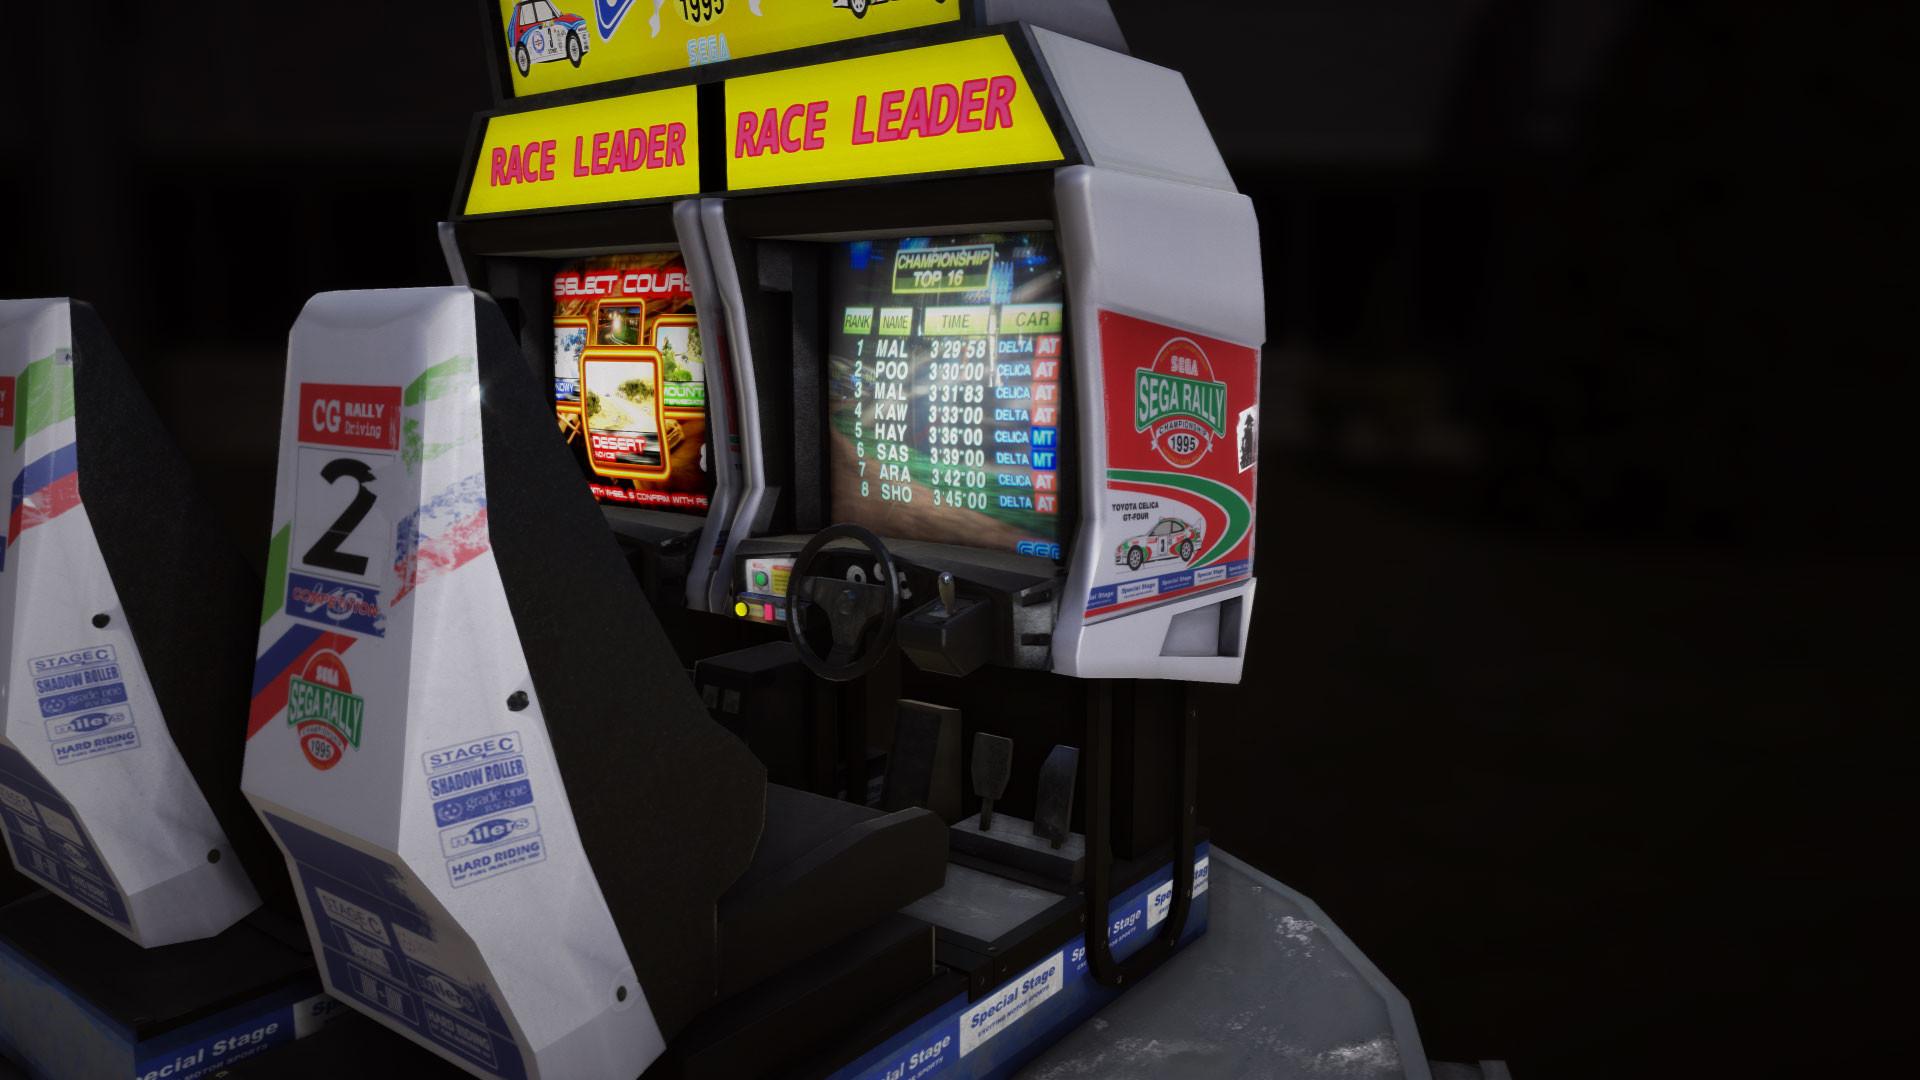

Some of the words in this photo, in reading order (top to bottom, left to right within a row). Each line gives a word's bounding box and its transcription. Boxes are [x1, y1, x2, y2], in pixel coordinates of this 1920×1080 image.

[687, 32, 731, 67] SEGA
[734, 101, 828, 158] RACE
[851, 75, 1017, 145] LEADER
[490, 139, 556, 187] RACE
[573, 122, 686, 178] LEADER
[898, 250, 990, 269] CHAMPIONSHIP
[554, 275, 618, 296] SELECT
[623, 272, 692, 294] COUR
[914, 271, 942, 287] TOP
[948, 270, 964, 286] 16
[845, 314, 870, 329] RANK
[882, 315, 908, 329] NAME
[942, 314, 970, 329] TIME
[1015, 311, 1049, 327] CAR
[857, 339, 864, 356] 1
[875, 339, 908, 358] MAL
[999, 340, 1033, 353] DELTA
[1036, 337, 1059, 354] AT
[854, 361, 863, 378] 2
[875, 362, 908, 380] POO
[996, 363, 1031, 377] CELICA
[1035, 360, 1056, 377] AT
[1171, 355, 1198, 376] SEGA
[556, 382, 574, 394] NOWY
[854, 383, 862, 398] 3
[874, 383, 907, 401] MAL
[996, 385, 1030, 399] CELICA
[1035, 385, 1055, 401] AT
[854, 402, 862, 418] 4
[875, 403, 908, 421] KAW
[995, 409, 1029, 421] DELTA
[1035, 407, 1054, 424] AT
[1139, 375, 1179, 422] SEGA
[1183, 383, 1224, 428] RALLY
[312, 399, 341, 432] CG
[345, 402, 384, 418] RALLY
[344, 421, 382, 438] Driving
[855, 422, 862, 438] 5
[875, 424, 907, 441] HAY
[995, 430, 1029, 443] CELICA
[1033, 430, 1055, 446] MT
[1158, 419, 1207, 437] CHAMPIONSHIP
[592, 435, 645, 452] DESERT
[857, 442, 864, 458] 6
[877, 444, 909, 462] SAS
[996, 451, 1029, 464] DELTA
[1034, 451, 1054, 467] MT
[1170, 436, 1196, 453] 1995
[858, 462, 866, 477] 7
[880, 464, 910, 483] ARA
[997, 474, 1031, 486] CELICA
[1035, 474, 1053, 489] AT
[861, 481, 869, 497] 8
[881, 485, 912, 503] SHO
[1000, 496, 1032, 509] DELTA
[1037, 496, 1054, 512] AT
[1112, 502, 1137, 512] TOYOTA
[1138, 501, 1159, 510] CELICA
[303, 458, 377, 575] 2
[1122, 512, 1149, 521] GT-FOUR
[1016, 540, 1061, 560] SE
[35, 651, 94, 669] STAGE
[95, 649, 109, 660] C
[36, 670, 83, 694] SHADOW
[85, 666, 119, 684] ROLLER
[288, 682, 321, 721] SEGA
[323, 690, 362, 744] RALLY
[56, 741, 92, 755] HARD
[94, 731, 135, 747] RIDING
[311, 740, 331, 758] 1995
[430, 740, 497, 766] STAGE
[498, 737, 513, 751] C
[431, 767, 484, 798] SHADOW
[485, 759, 525, 783] ROLLER
[452, 855, 492, 875] HARD
[494, 841, 540, 863] RIDING
[1193, 865, 1208, 879] tag
[1113, 909, 1142, 934] Stage
[970, 987, 1019, 1029] Special
[1021, 965, 1056, 994] Stage
[212, 1022, 280, 1056] Stage
[908, 1035, 951, 1070] Stage
